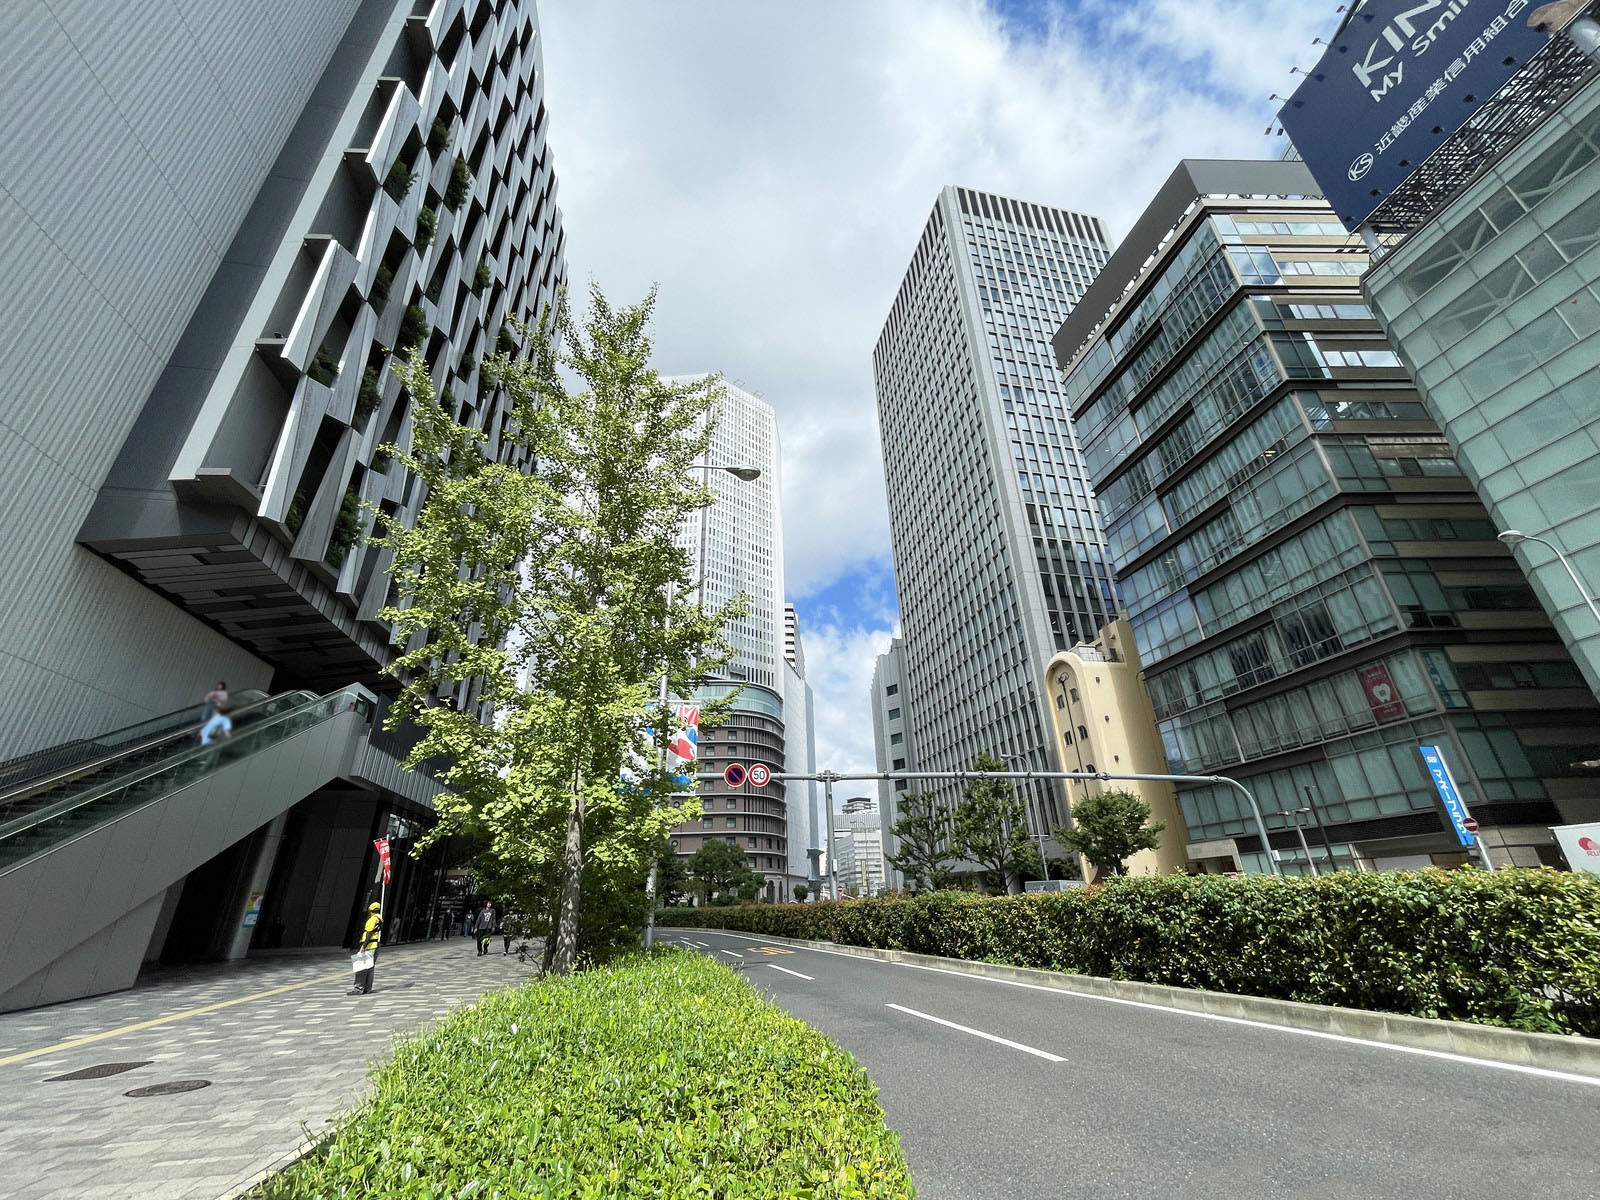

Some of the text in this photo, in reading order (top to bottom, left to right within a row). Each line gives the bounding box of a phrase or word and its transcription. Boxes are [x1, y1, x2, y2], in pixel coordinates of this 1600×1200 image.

[1370, 0, 1469, 102] My Smi
[1349, 154, 1373, 180] KS
[753, 770, 766, 780] 50
